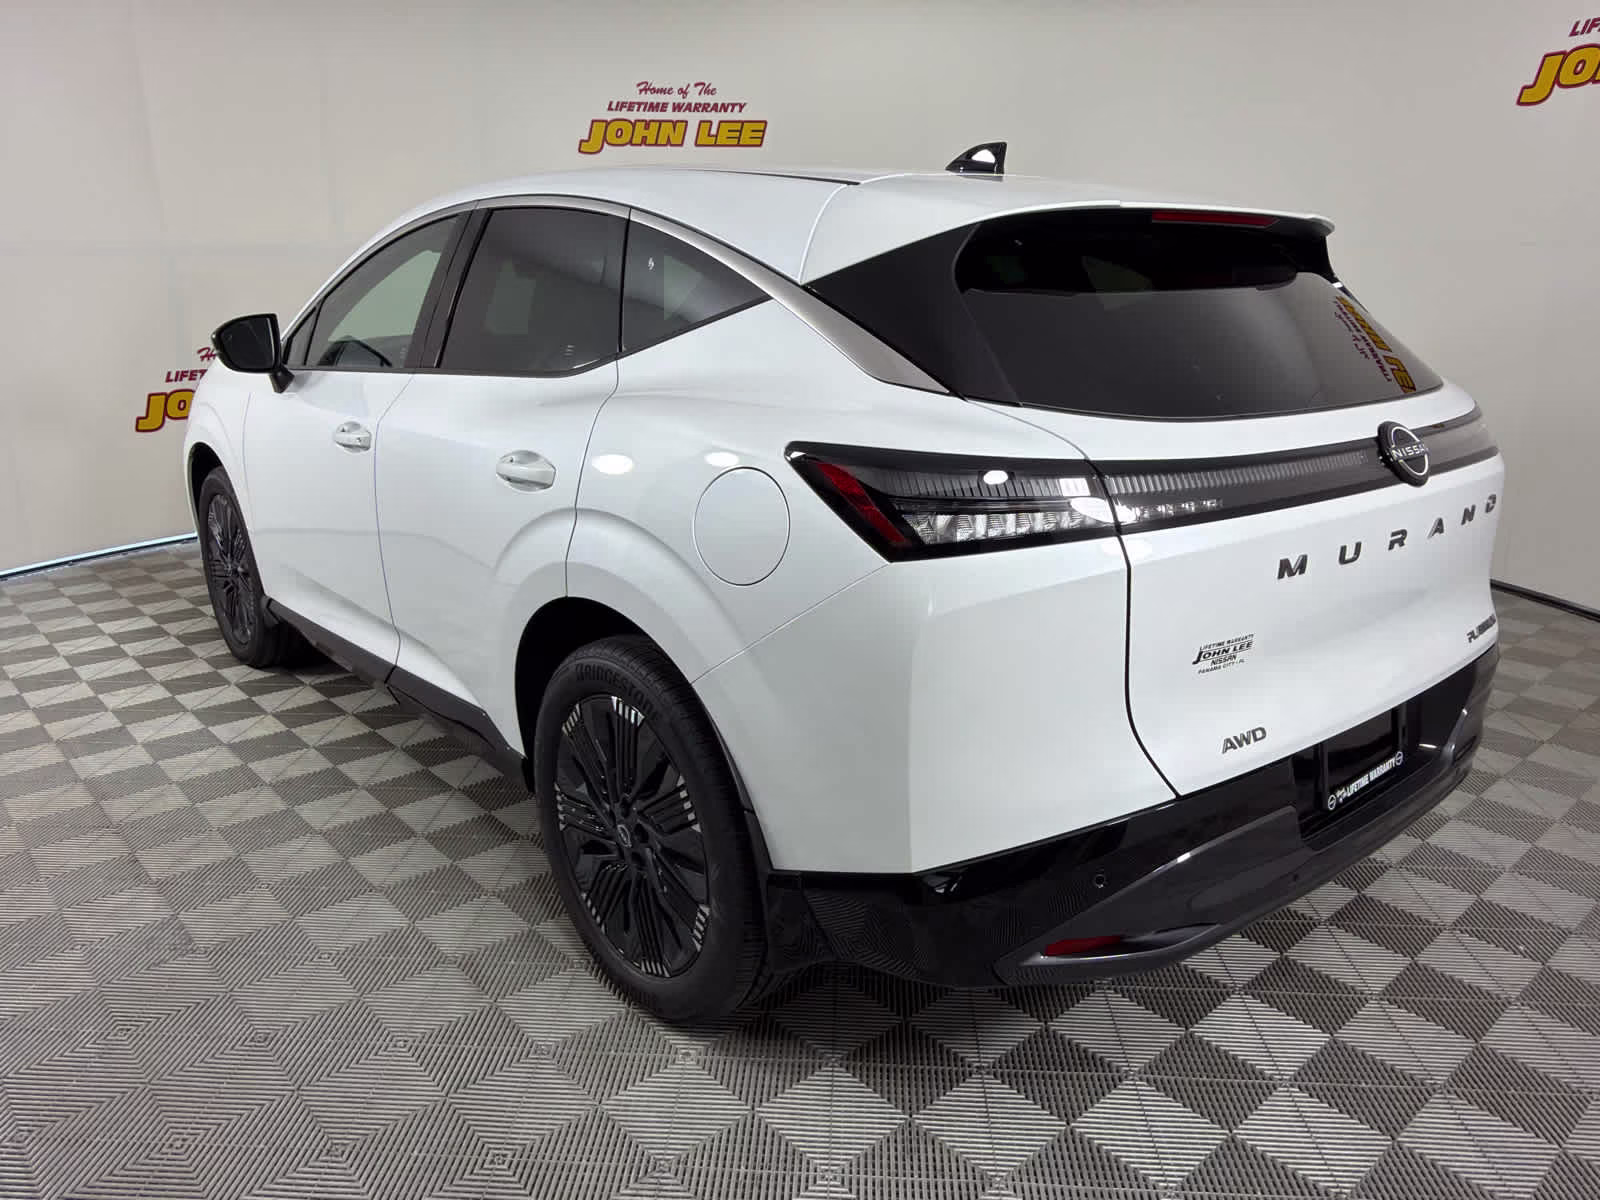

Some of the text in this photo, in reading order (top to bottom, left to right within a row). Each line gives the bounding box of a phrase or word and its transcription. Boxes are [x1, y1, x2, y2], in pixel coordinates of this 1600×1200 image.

[1516, 43, 1600, 106] JO
[636, 81, 717, 99] Home of The
[607, 101, 747, 113] LIFETIME WARRANTY
[578, 118, 767, 154] JOHN LEE
[165, 369, 208, 383] LIFET
[135, 389, 196, 432] JO
[1277, 494, 1497, 580] MURANO
[1192, 641, 1253, 665] JOHN LEE
[1211, 655, 1237, 666] NISSAN
[1222, 727, 1267, 754] AWD
[1346, 757, 1396, 797] LIFETIME WARRANTY
